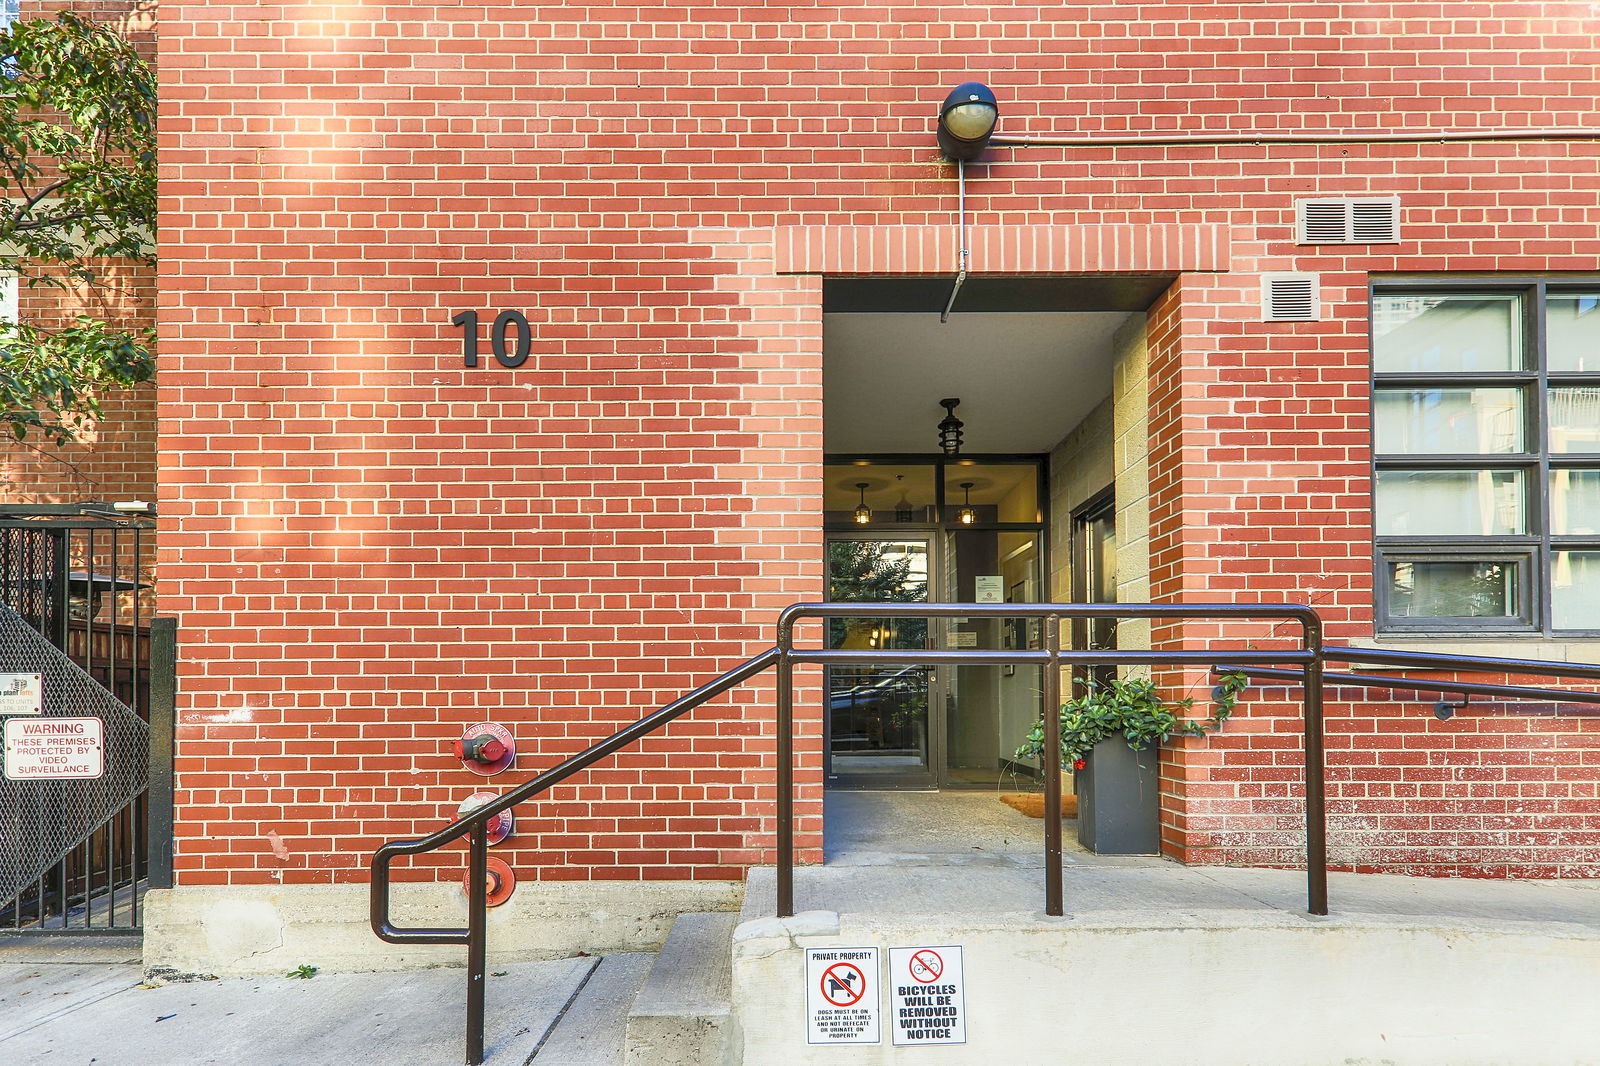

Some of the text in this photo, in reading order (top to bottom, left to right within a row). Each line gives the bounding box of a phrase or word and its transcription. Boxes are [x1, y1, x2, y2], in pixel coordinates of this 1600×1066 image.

[451, 310, 531, 368] 10
[23, 723, 84, 734] WARNING
[468, 723, 486, 736] AUTO
[12, 737, 96, 746] THESE PREMISES
[17, 747, 73, 755] PROTECTED
[38, 756, 68, 764] VIDEO
[18, 765, 90, 773] SURVEILLANCE
[812, 952, 872, 961] PRIVATE PROPERTY
[898, 984, 957, 996] BICYCLES
[904, 995, 952, 1007] WILL BE
[899, 1006, 957, 1018] REMOVED
[899, 1017, 958, 1029] WITHOUT
[907, 1028, 952, 1039] NOTICE
